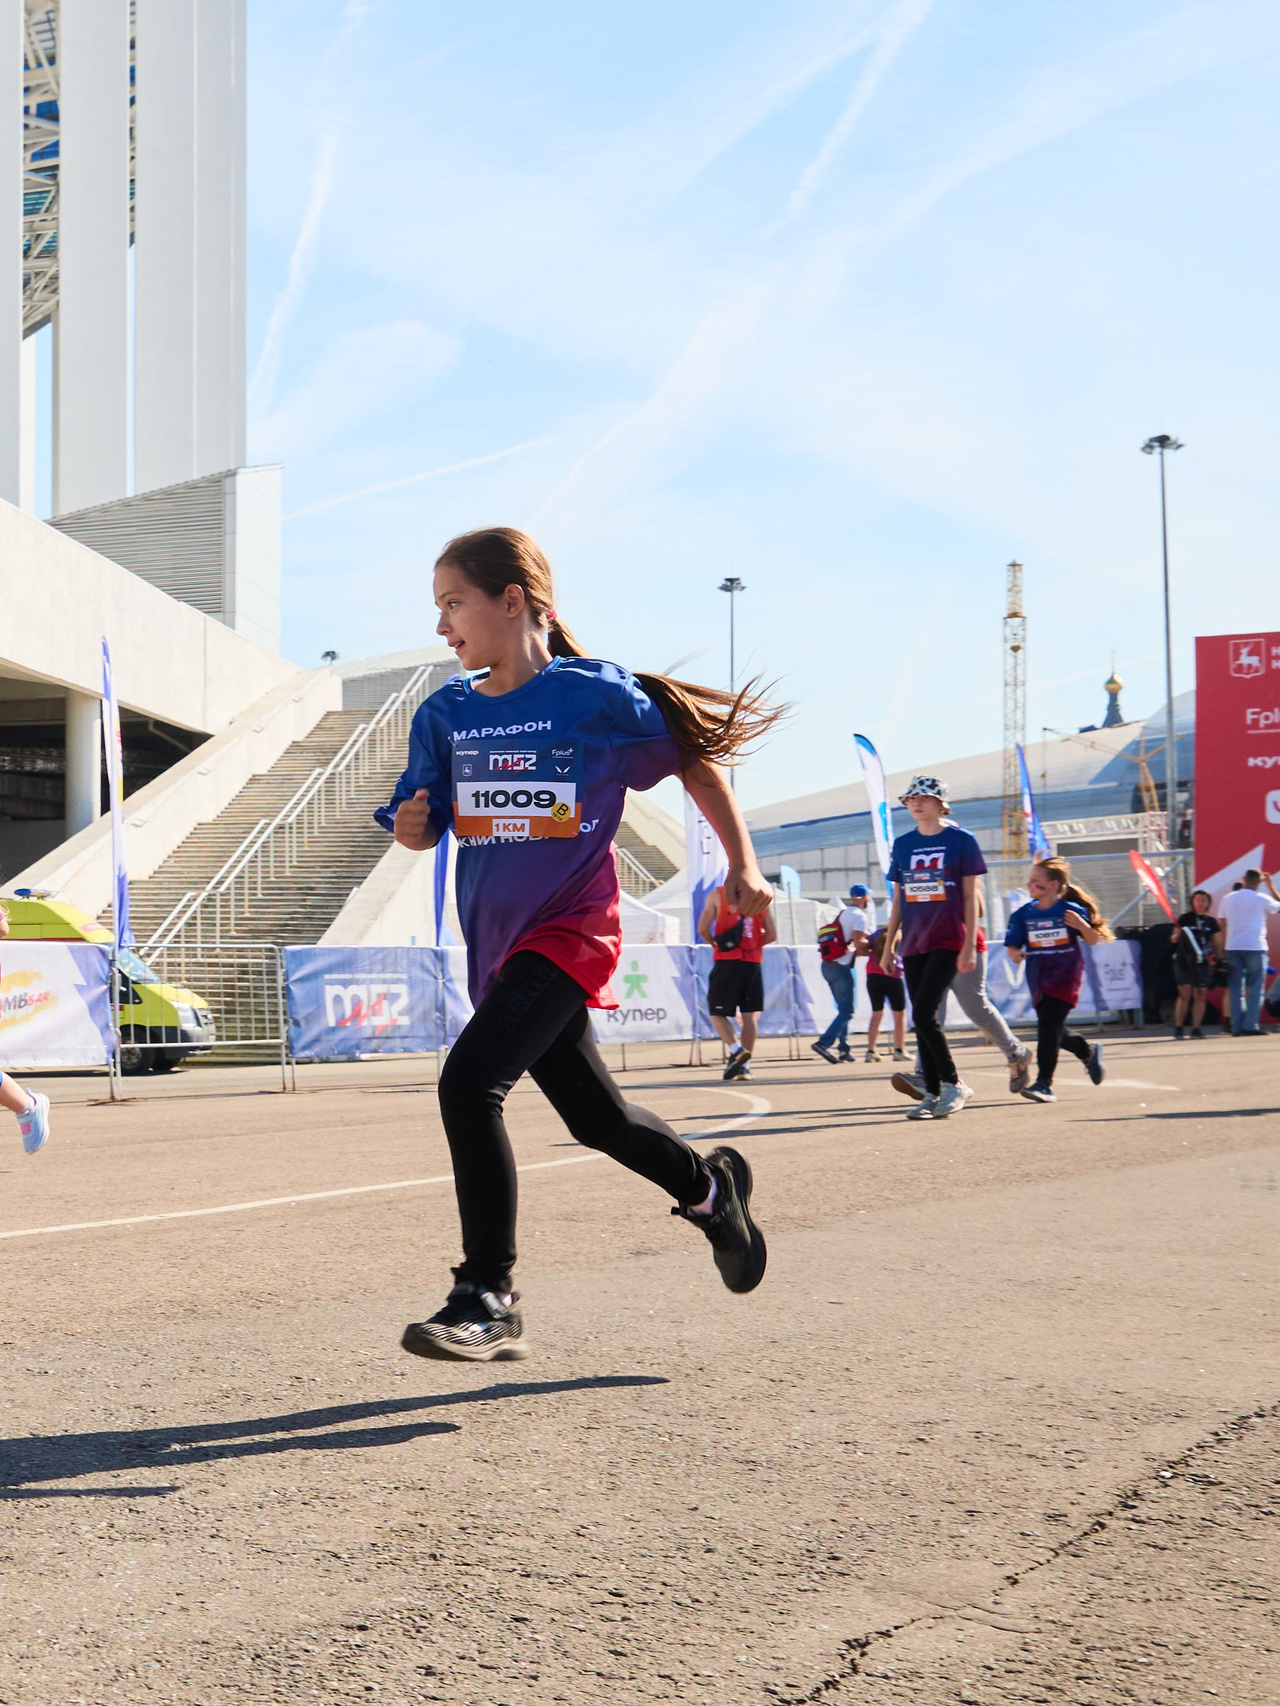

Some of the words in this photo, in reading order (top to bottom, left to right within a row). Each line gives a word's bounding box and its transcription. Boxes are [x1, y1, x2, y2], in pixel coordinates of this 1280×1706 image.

[1245, 708, 1280, 728] Fpl
[453, 720, 552, 742] МАРАФОН
[471, 789, 557, 809] 11009
[606, 1007, 668, 1026] купер
